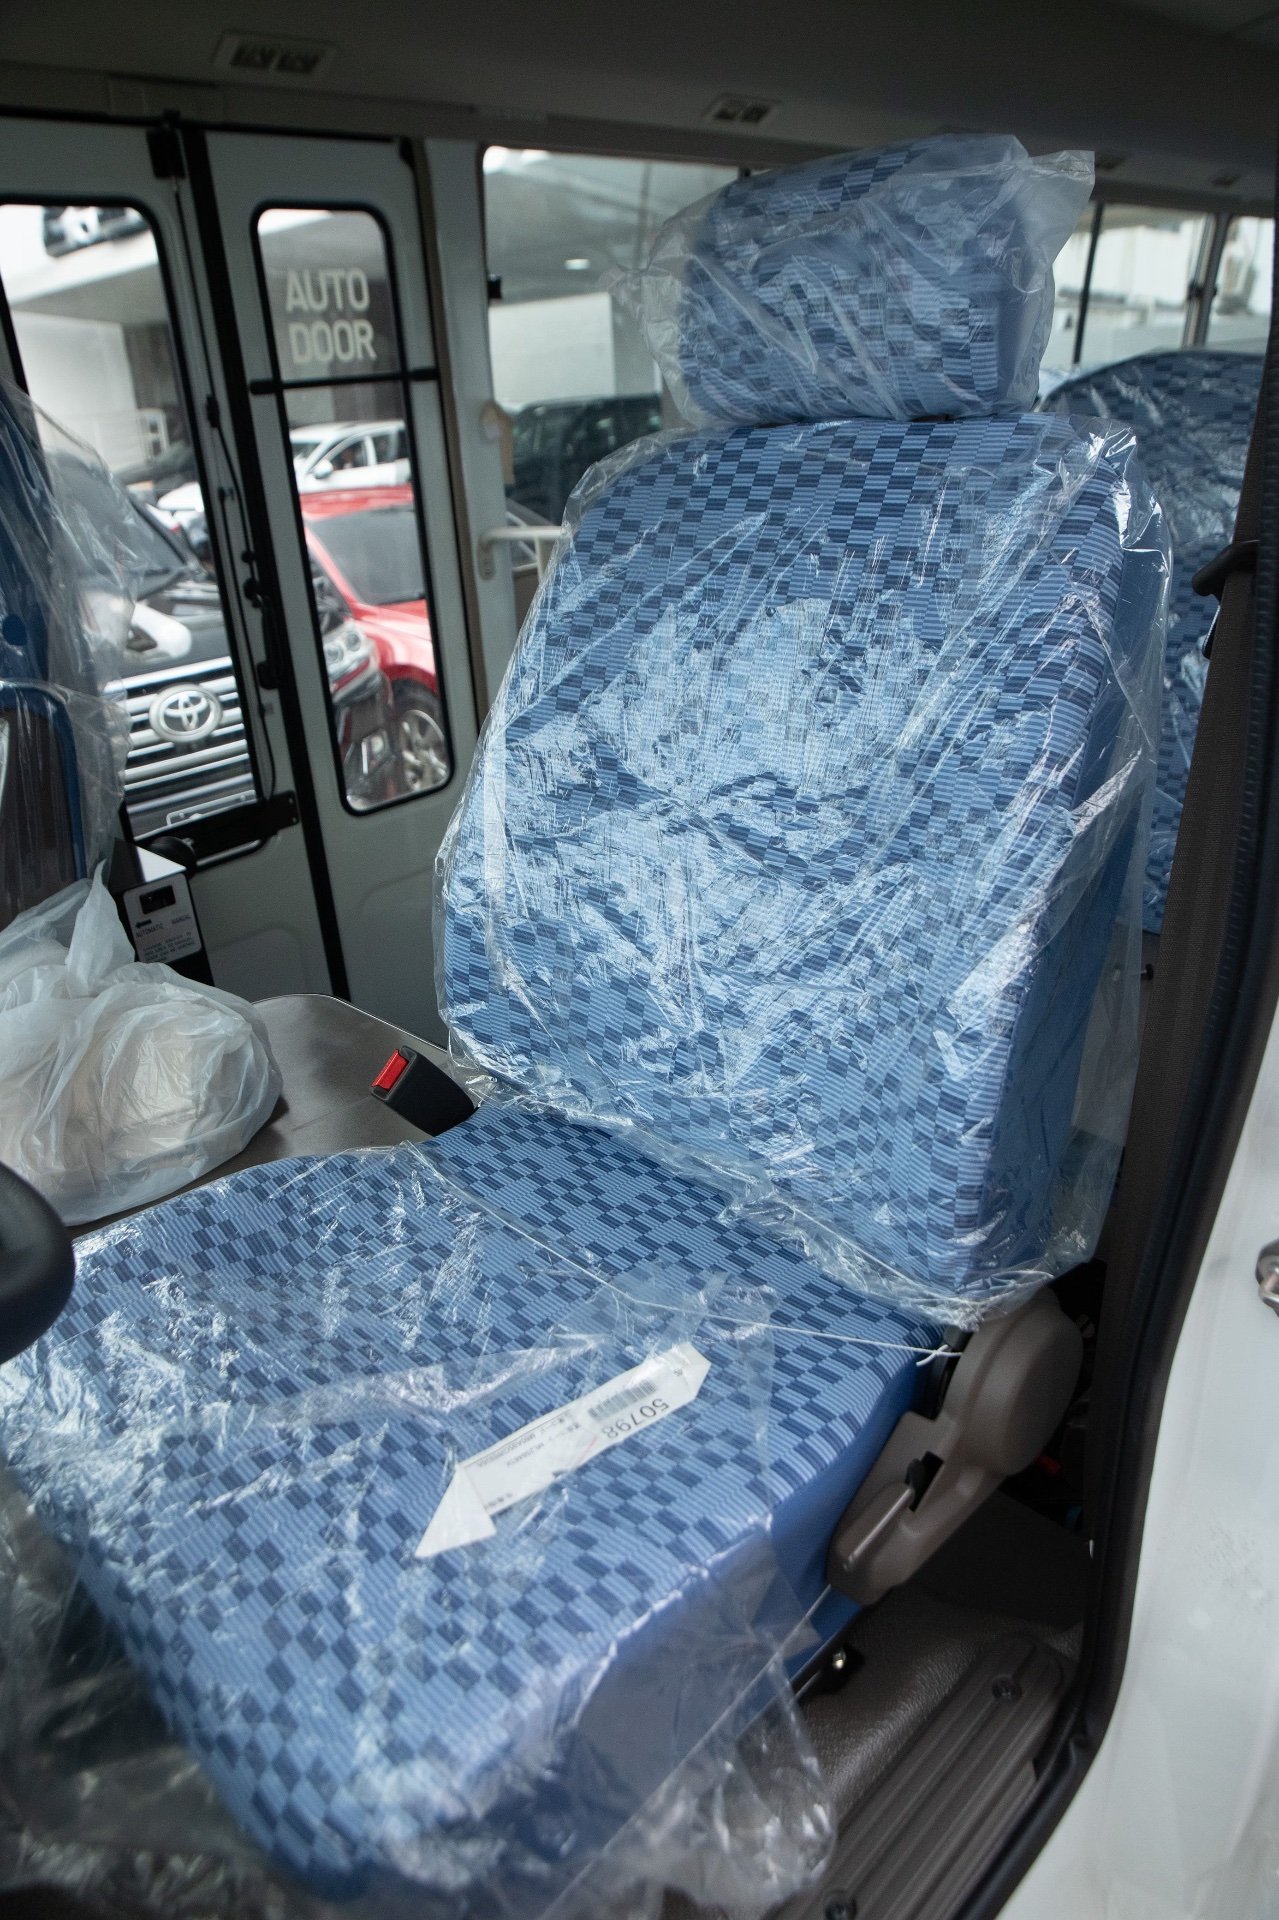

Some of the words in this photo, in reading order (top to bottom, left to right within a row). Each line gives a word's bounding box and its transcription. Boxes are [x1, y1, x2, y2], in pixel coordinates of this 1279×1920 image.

[286, 267, 370, 312] AUTO
[289, 319, 377, 363] DOOR
[602, 1398, 669, 1439] 50798
